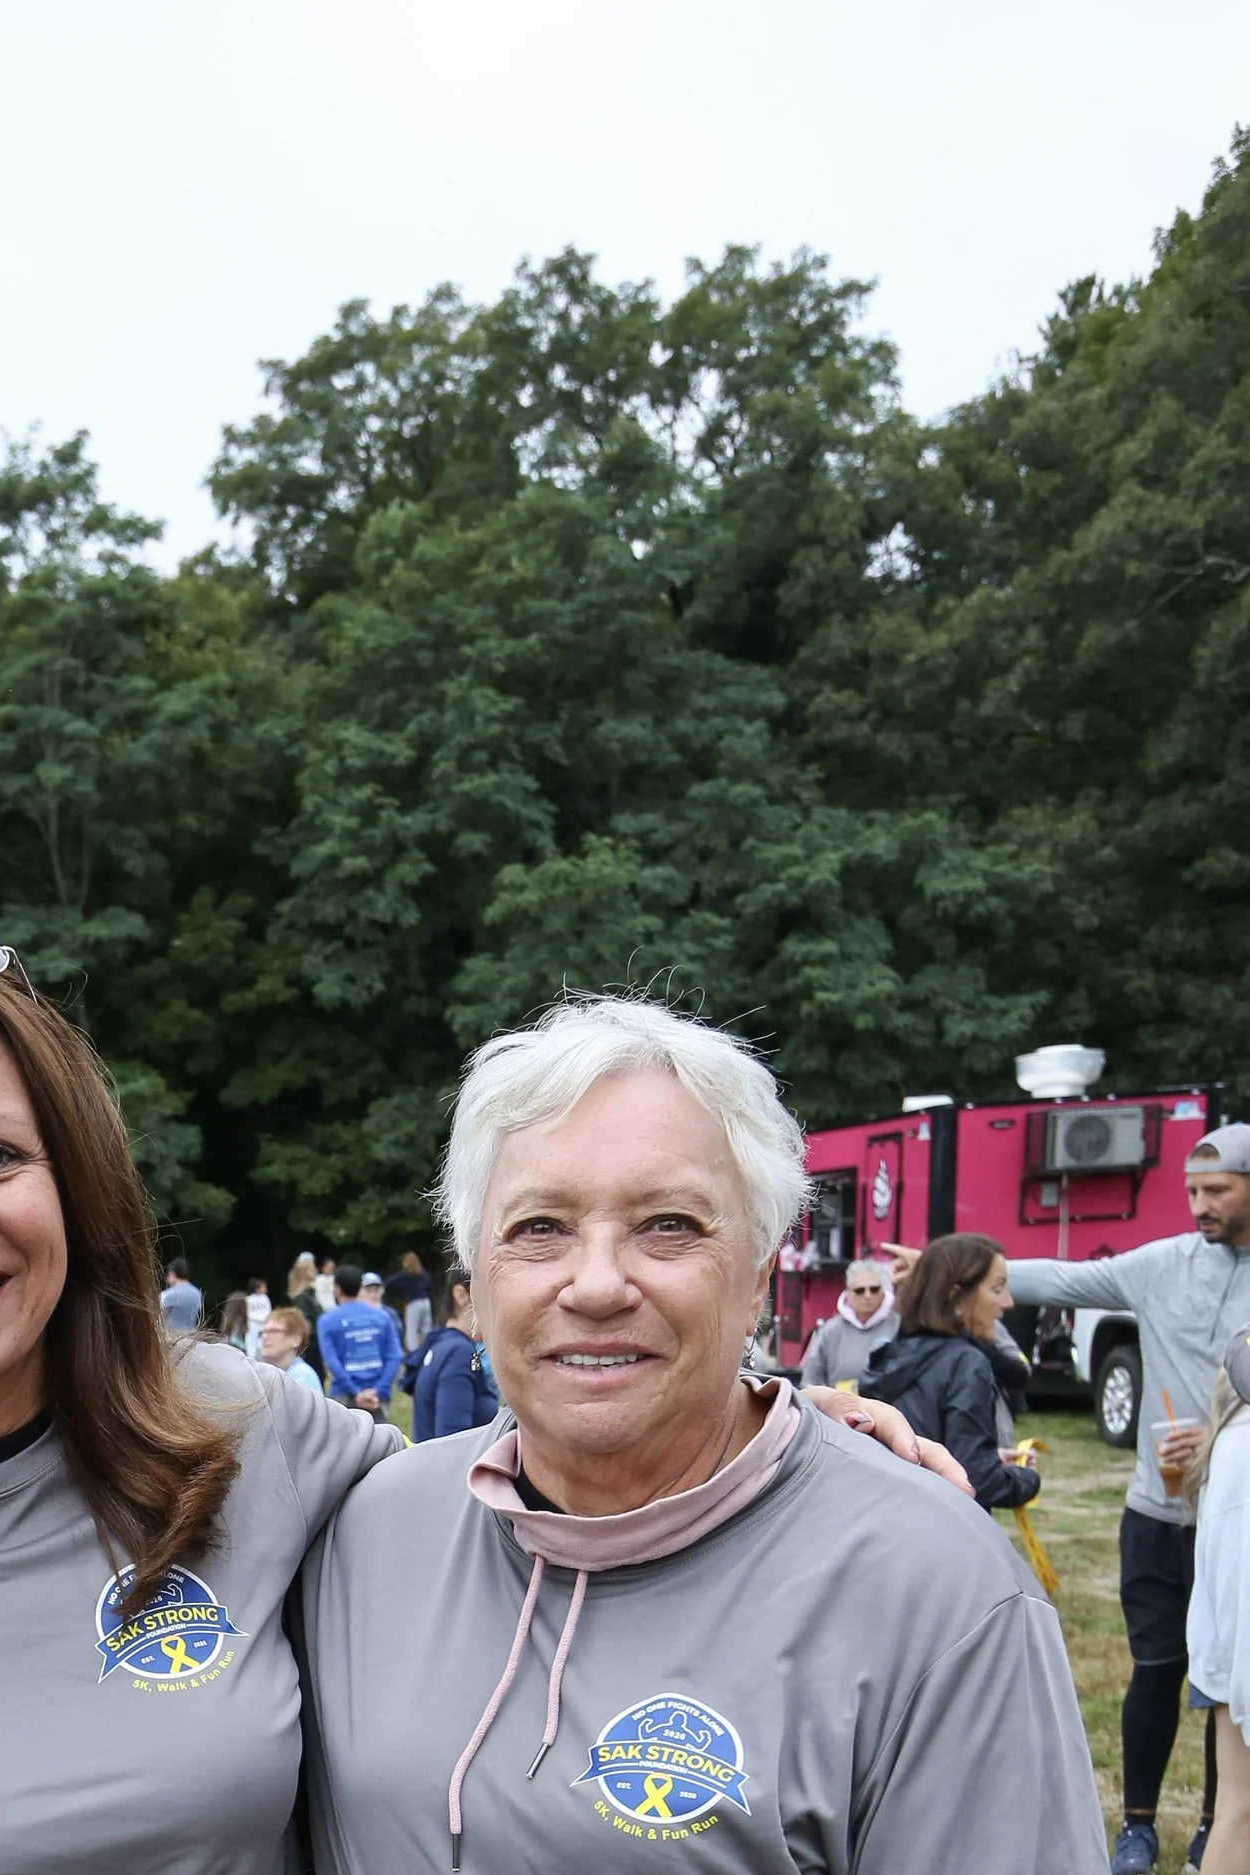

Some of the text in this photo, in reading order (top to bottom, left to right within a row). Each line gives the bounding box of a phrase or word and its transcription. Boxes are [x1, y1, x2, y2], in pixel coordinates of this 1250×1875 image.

[106, 1607, 218, 1652] SAK STRONG
[132, 1650, 235, 1692] 5K, Walk & Fun Run
[631, 1701, 726, 1737] NO ONE FIGHTS ALONE
[598, 1745, 735, 1782] SAK STRONG
[593, 1800, 719, 1840] 5K, Walk & Fun Run
